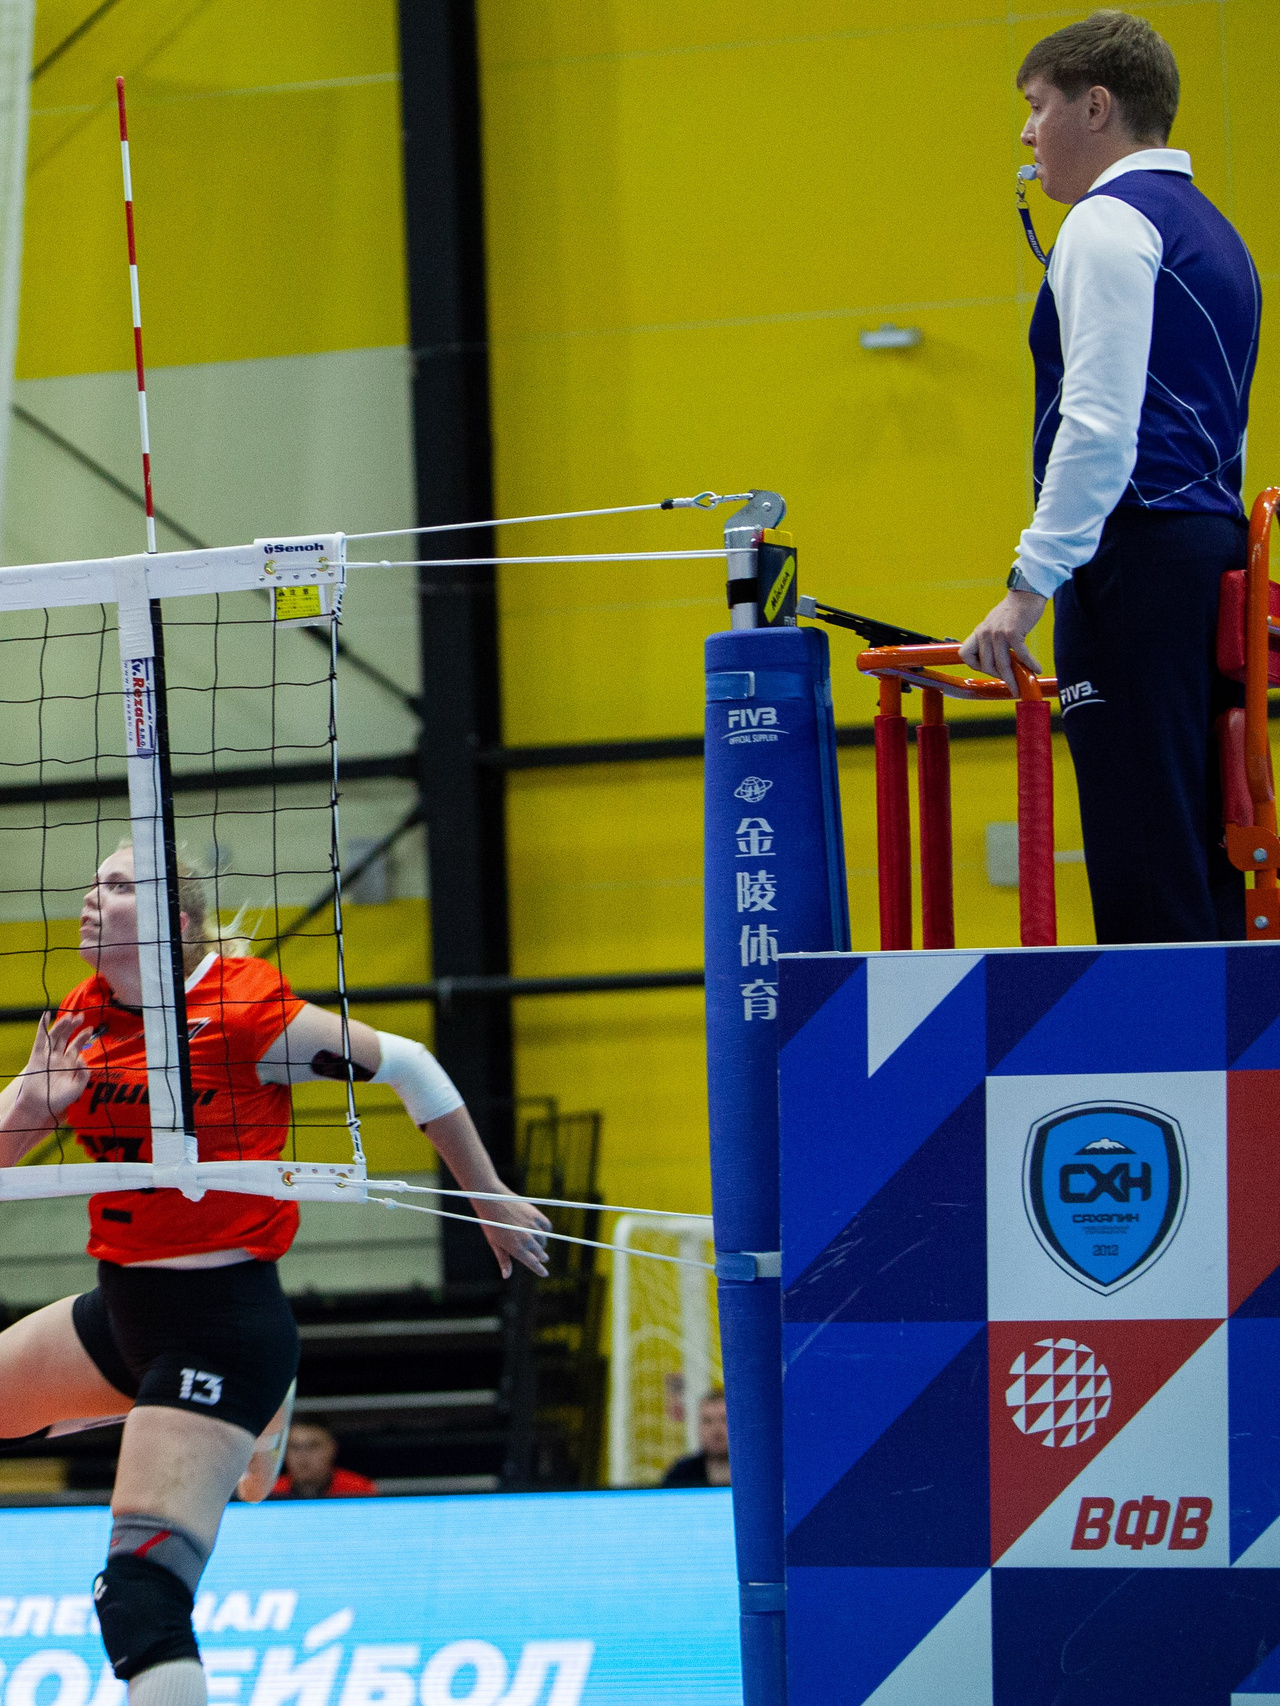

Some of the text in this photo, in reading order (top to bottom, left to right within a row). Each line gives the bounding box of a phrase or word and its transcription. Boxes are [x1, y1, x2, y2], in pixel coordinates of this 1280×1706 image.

[274, 543, 324, 553] Senoh
[1060, 681, 1092, 704] FIVB
[728, 707, 778, 728] FIVB
[1093, 1244, 1119, 1256] 2012
[179, 1367, 224, 1405] 13
[1071, 1495, 1213, 1551] ВФВ
